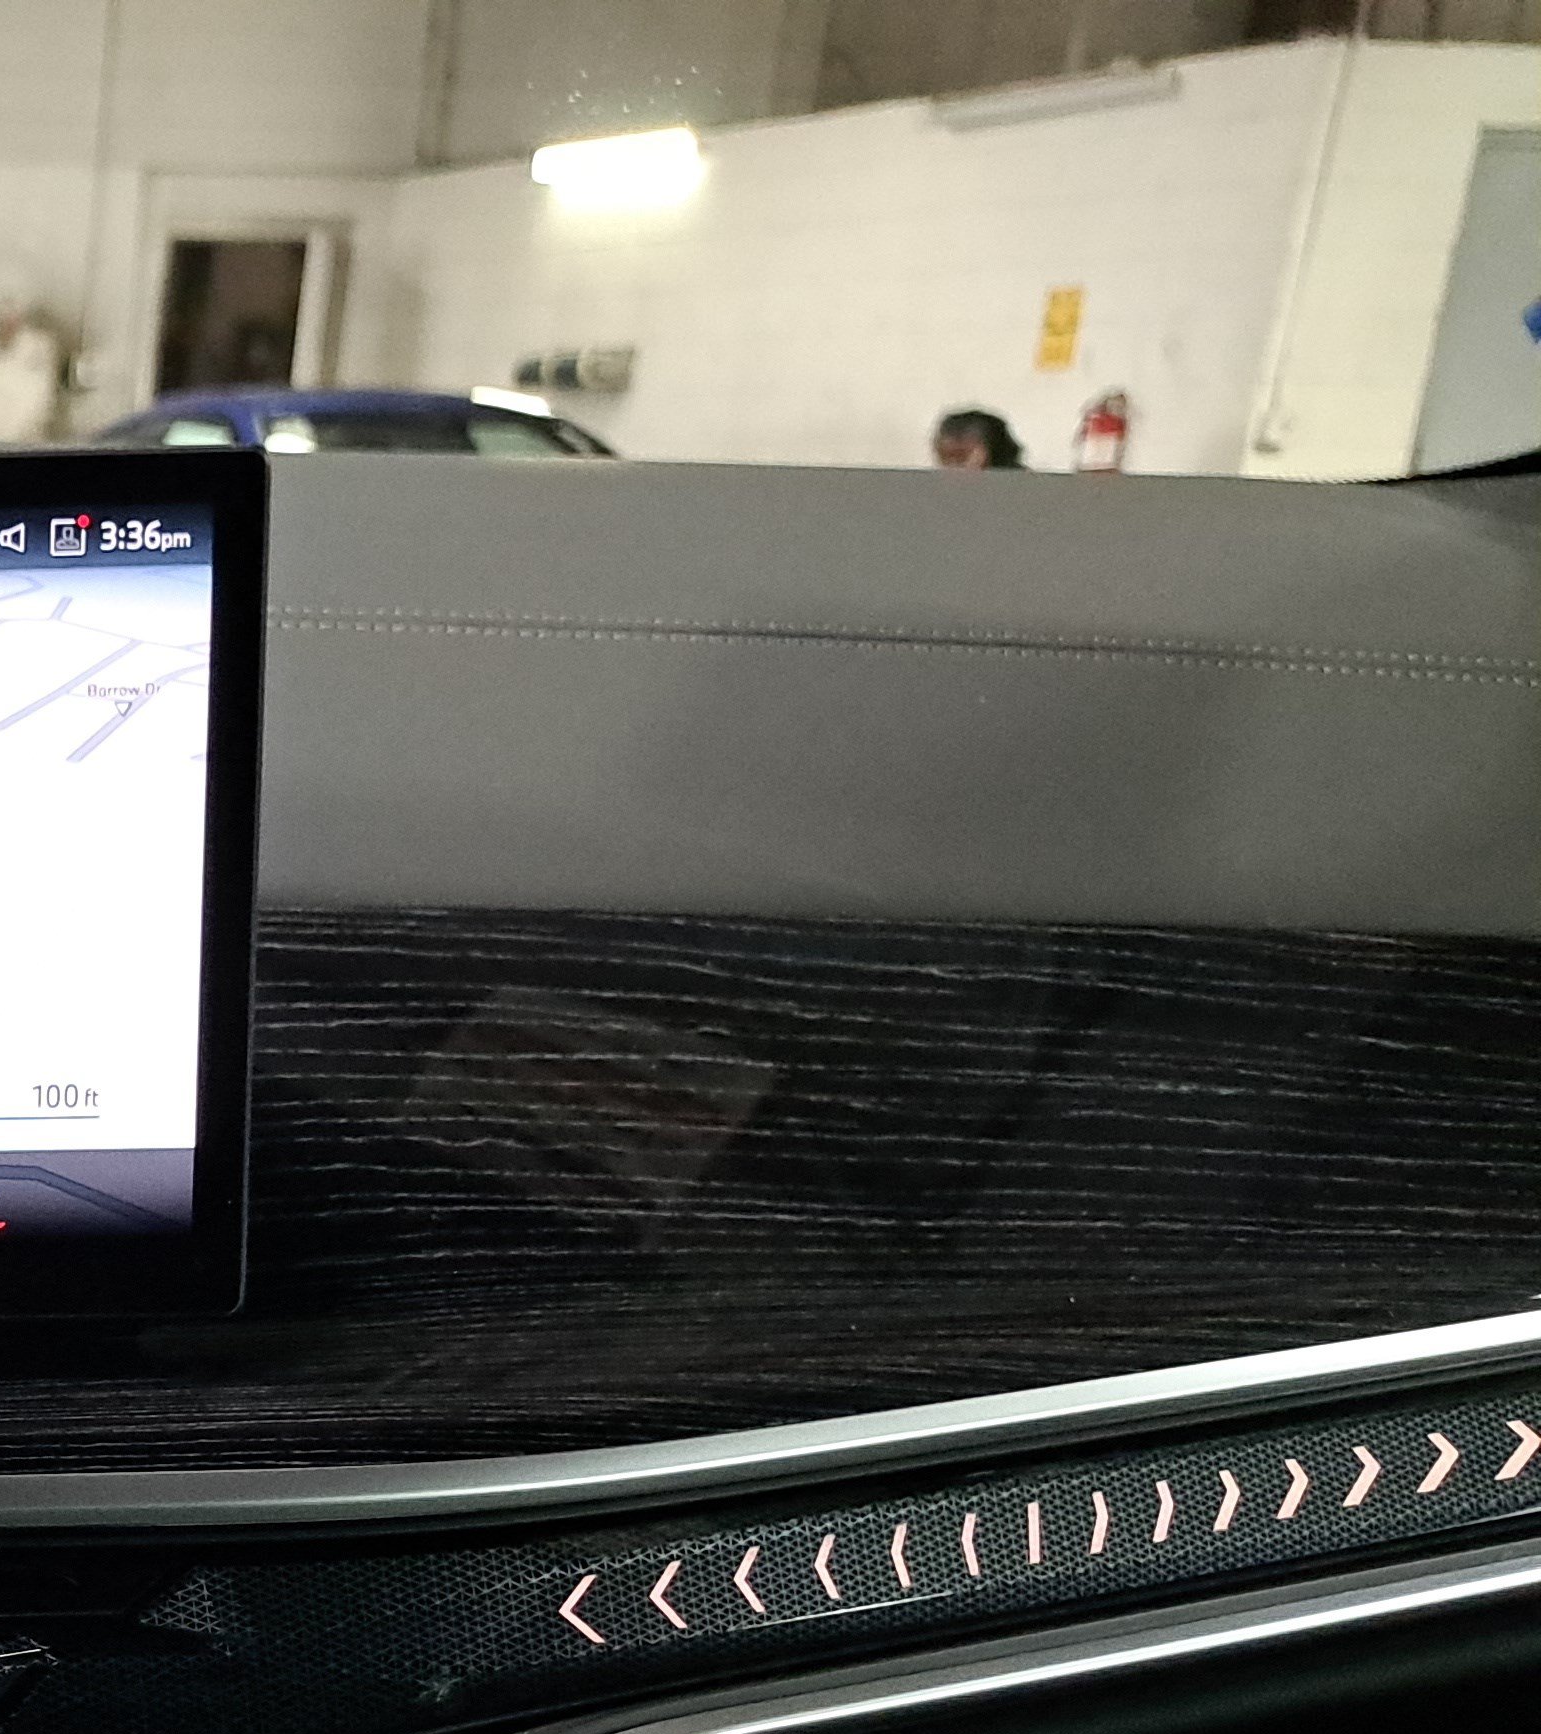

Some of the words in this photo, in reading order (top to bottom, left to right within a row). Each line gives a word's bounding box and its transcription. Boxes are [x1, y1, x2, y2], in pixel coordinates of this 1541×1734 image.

[98, 520, 192, 554] 3:36pm
[87, 684, 141, 698] Barrow
[32, 1083, 79, 1109] 100
[84, 1087, 100, 1107] ft
